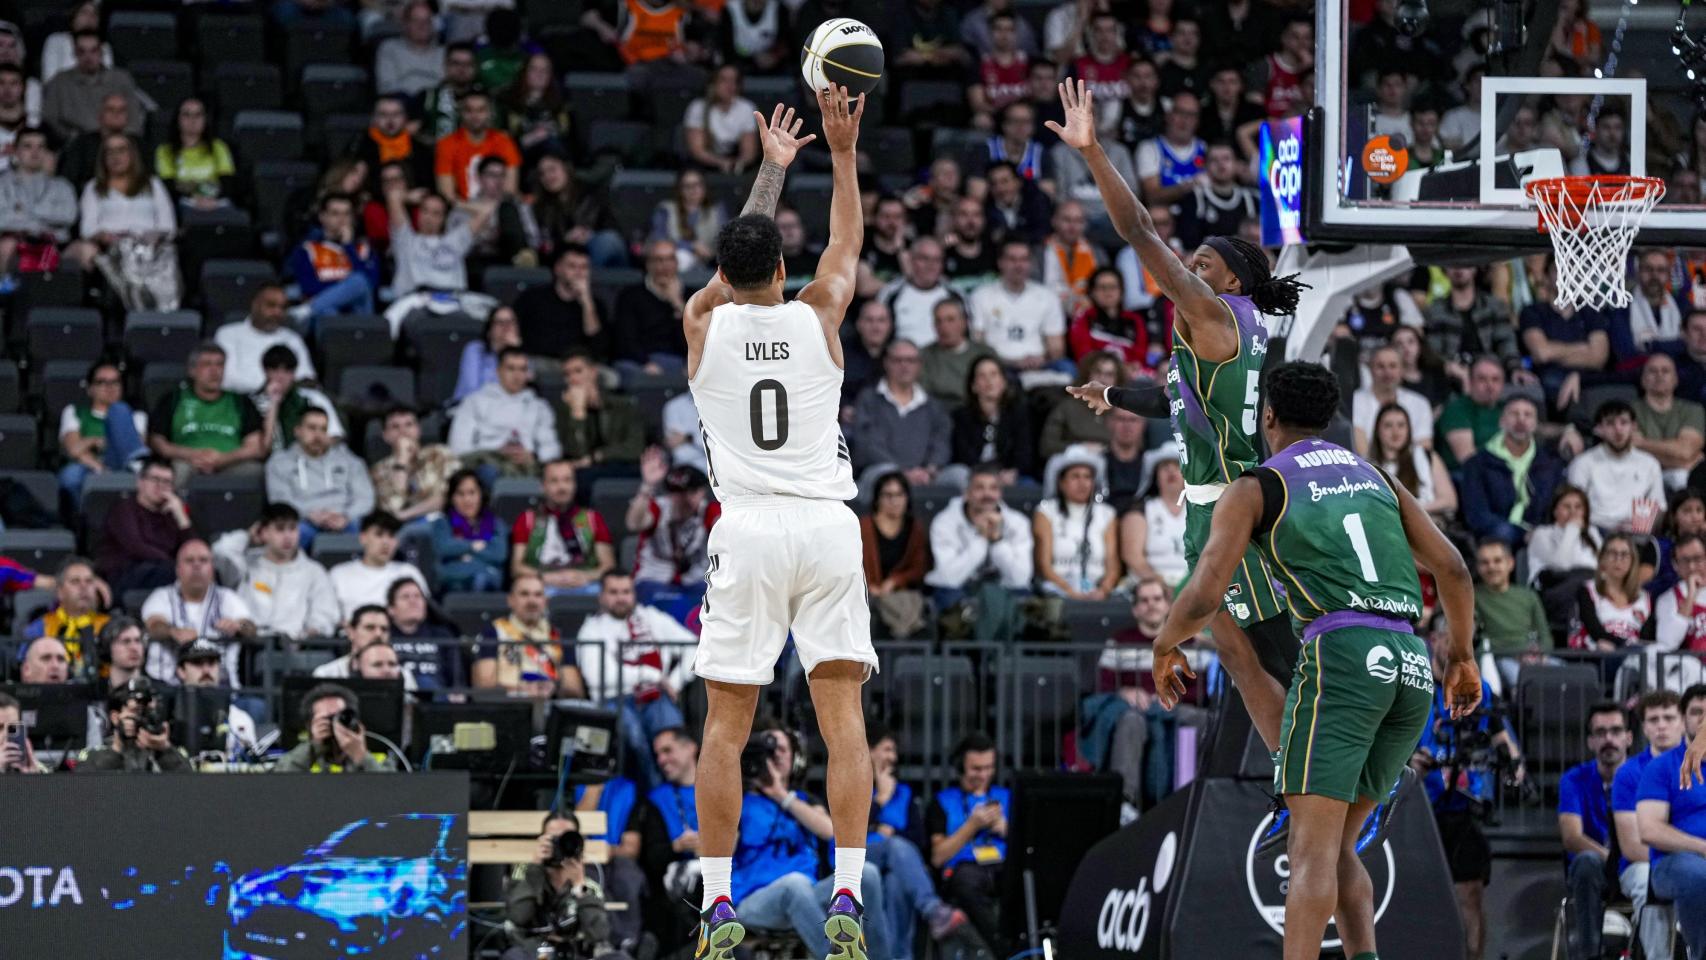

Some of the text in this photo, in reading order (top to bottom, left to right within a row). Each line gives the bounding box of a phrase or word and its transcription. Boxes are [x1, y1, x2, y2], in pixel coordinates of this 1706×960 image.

[1278, 132, 1299, 163] acb
[745, 342, 790, 360] LYLES
[750, 379, 789, 451] 0
[1294, 449, 1358, 469] AUDIGE
[1342, 512, 1379, 582] 1
[1402, 662, 1422, 677] DEL
[0, 866, 83, 908] OTA
[1097, 876, 1151, 952] acb
